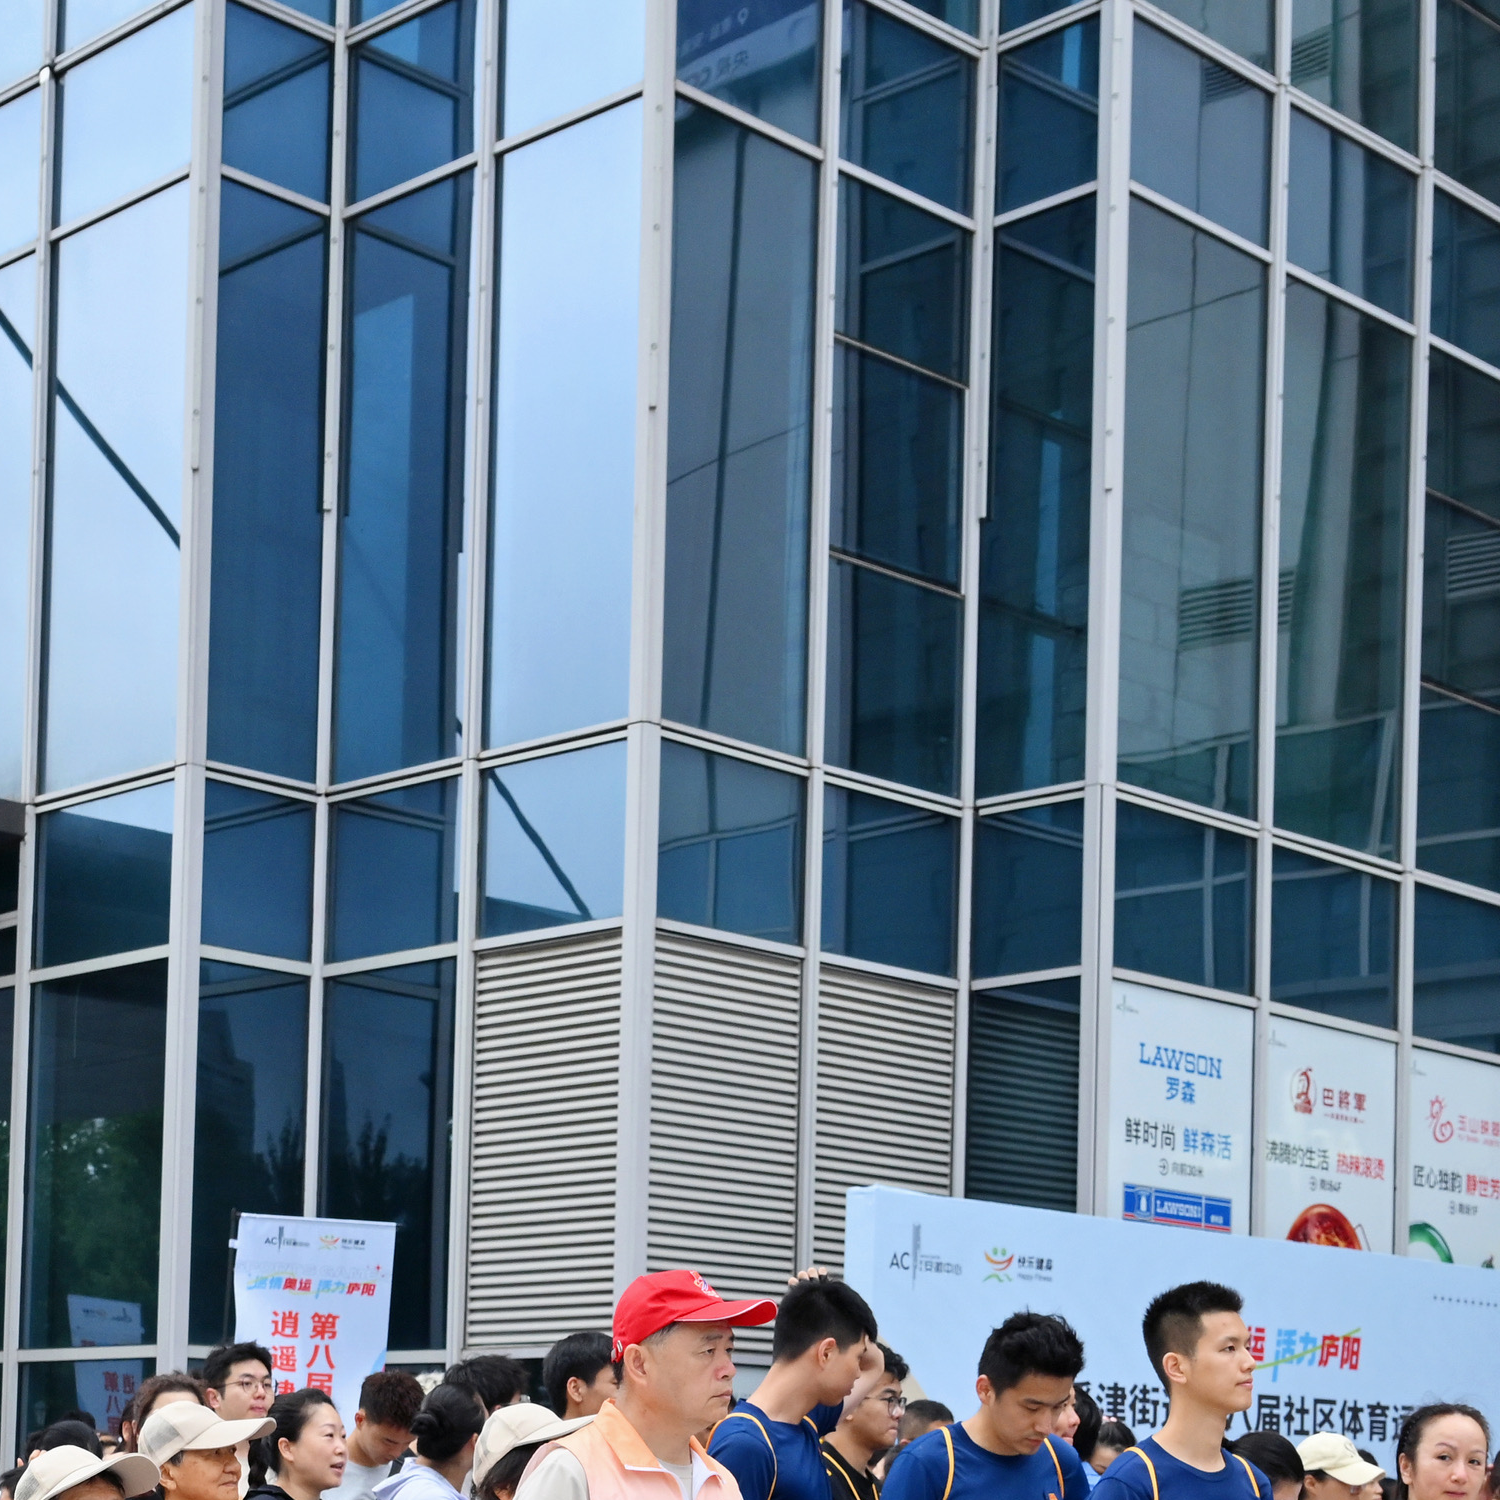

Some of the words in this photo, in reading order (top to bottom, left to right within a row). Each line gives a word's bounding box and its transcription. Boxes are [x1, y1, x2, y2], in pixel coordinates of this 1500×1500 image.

[1139, 1042, 1222, 1079] LAWSON
[1166, 1077, 1196, 1104] 罗森
[1125, 1117, 1176, 1151] 鲜时尚
[1183, 1127, 1232, 1160] 鲜森活
[890, 1252, 910, 1270] AC
[1272, 1328, 1362, 1381] 活力庐阳
